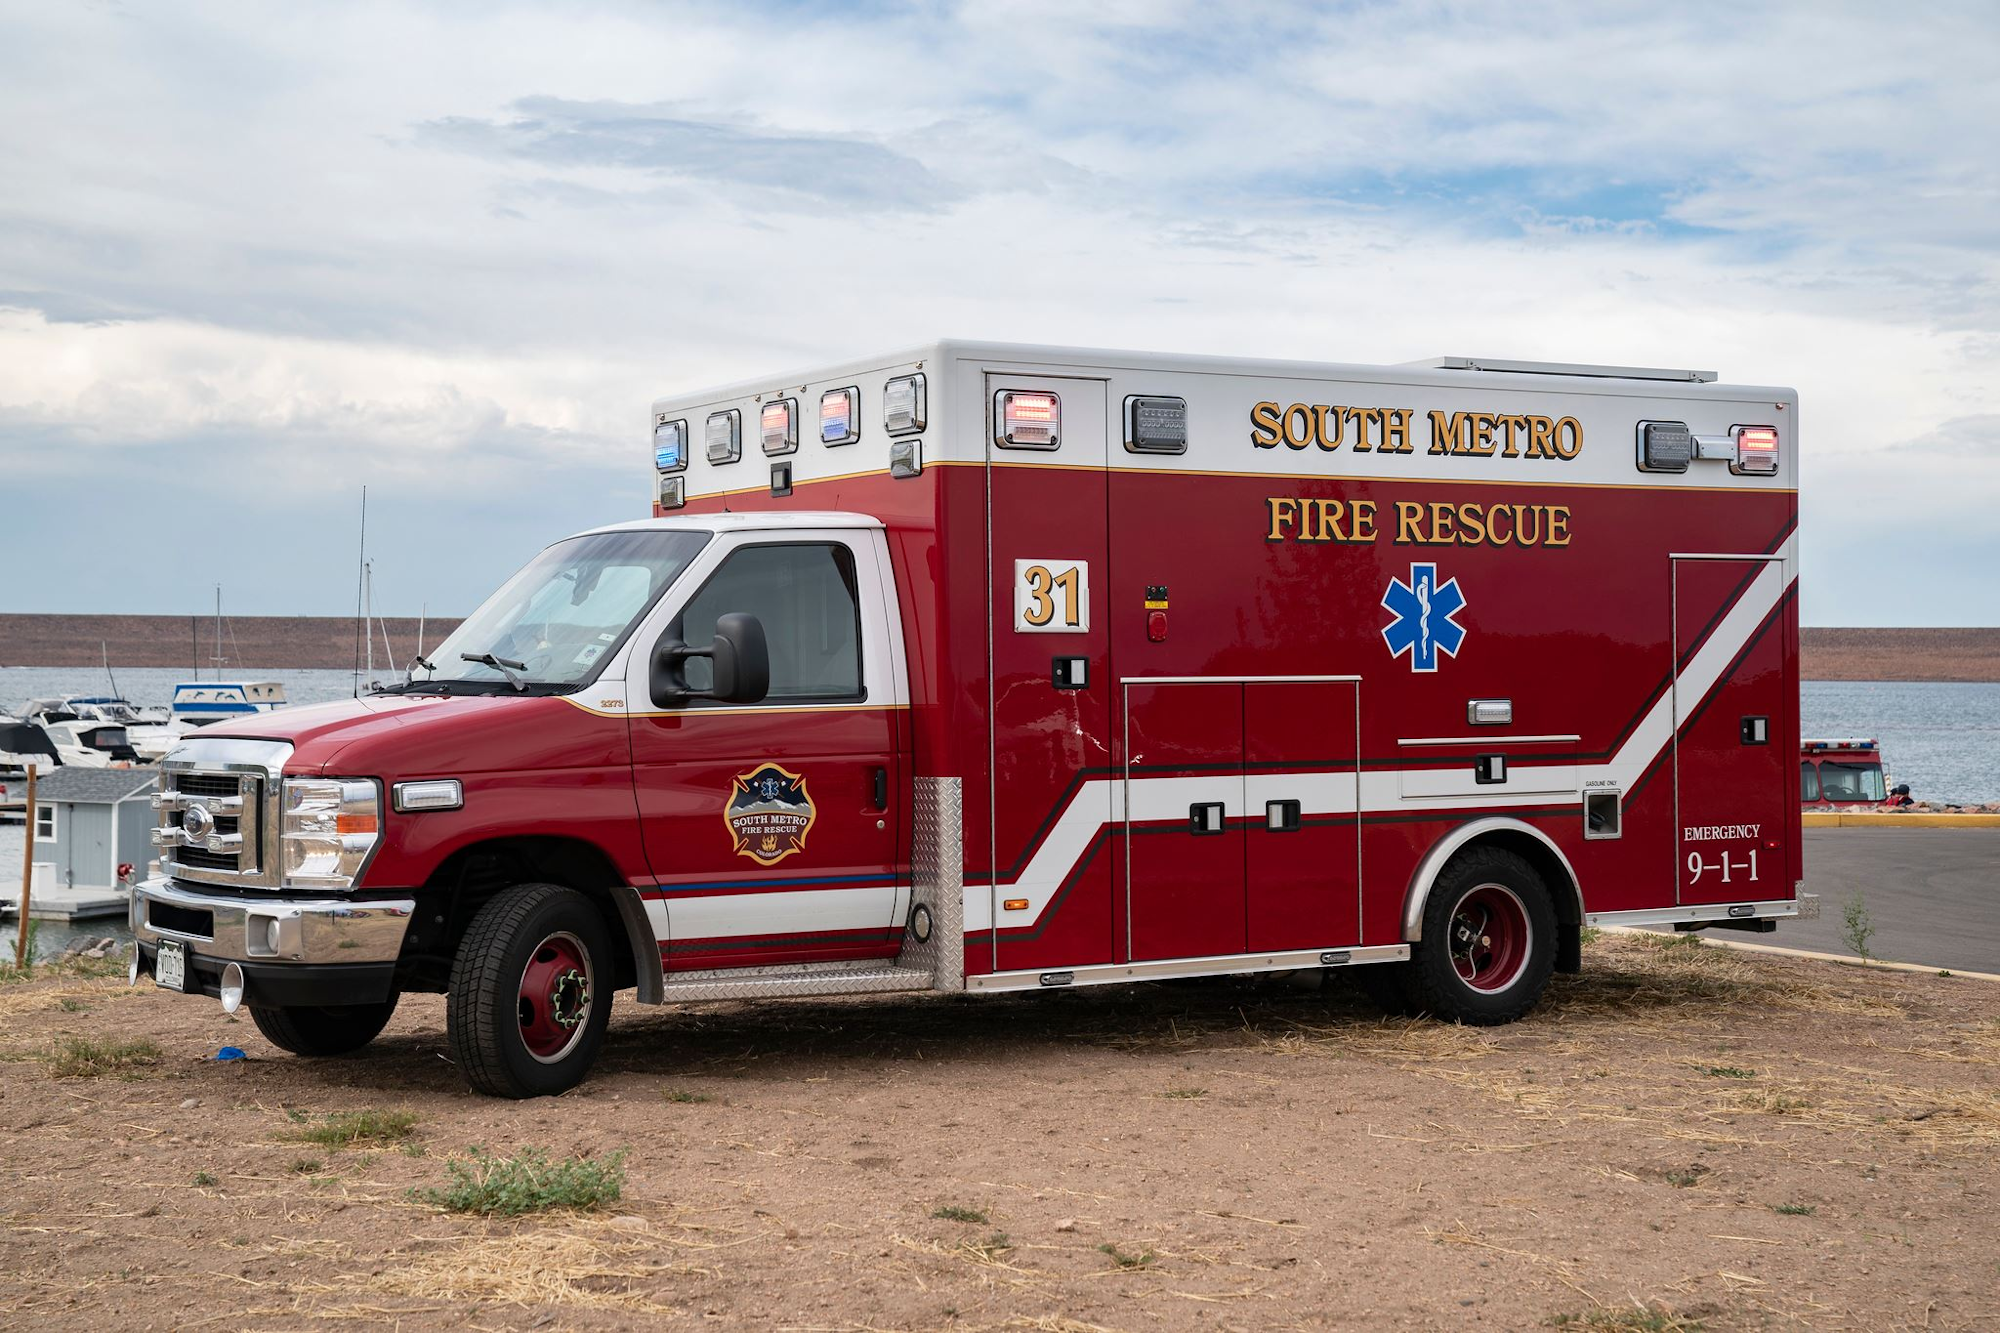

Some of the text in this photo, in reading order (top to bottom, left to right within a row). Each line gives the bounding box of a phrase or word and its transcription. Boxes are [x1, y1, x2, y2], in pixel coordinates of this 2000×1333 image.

[1250, 401, 1584, 460] SOUTH METRO
[1265, 497, 1573, 548] FIRE RESCUE
[1023, 565, 1079, 627] 31
[733, 815, 808, 828] SOUTH METRO
[764, 825, 798, 834] RESCUE
[1683, 824, 1761, 841] EMERGENCY
[756, 849, 782, 857] COLORADO
[1687, 849, 1759, 885] 9-1-1
